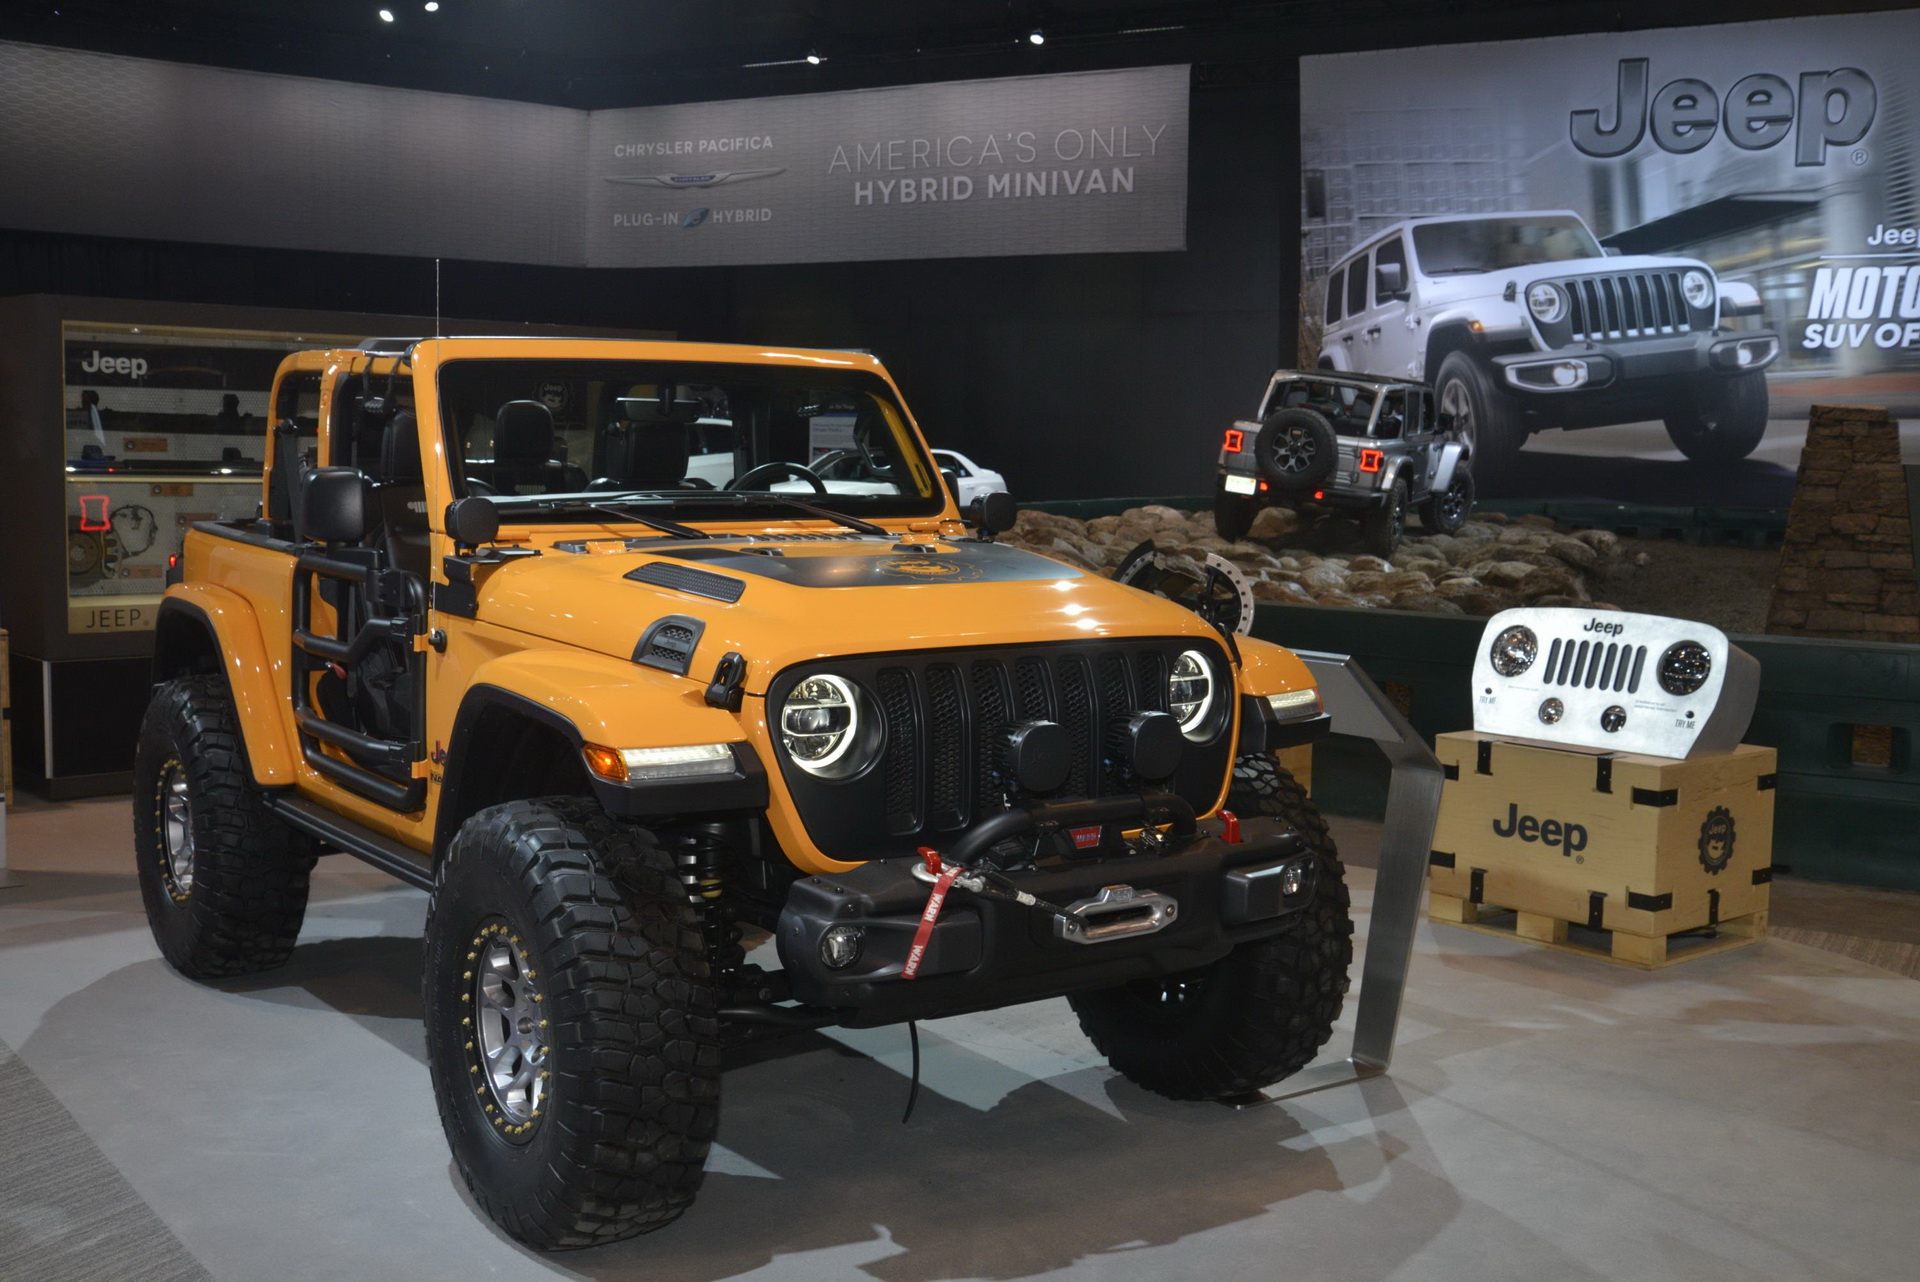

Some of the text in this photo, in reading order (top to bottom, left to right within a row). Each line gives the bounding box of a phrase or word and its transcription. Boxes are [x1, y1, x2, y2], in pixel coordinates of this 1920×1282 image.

[1569, 56, 1878, 168] Jeep
[614, 135, 774, 158] CHRYSLER PACIFICA
[828, 124, 1167, 174] AMERICA'S ONLY
[854, 167, 1135, 206] HYBRID MINIVAN
[613, 207, 772, 227] PLUG-IN HYBRID
[1866, 223, 1920, 249] Jee
[1801, 321, 1920, 349] SUV OF
[81, 350, 148, 379] Jeep
[86, 608, 141, 628] JEEP
[1583, 617, 1624, 637] Jeep
[1479, 695, 1488, 704] TRY
[1675, 718, 1696, 729] TRY ME
[1492, 802, 1588, 857] Jeep
[924, 893, 943, 922] WARN
[905, 945, 924, 976] WARN
